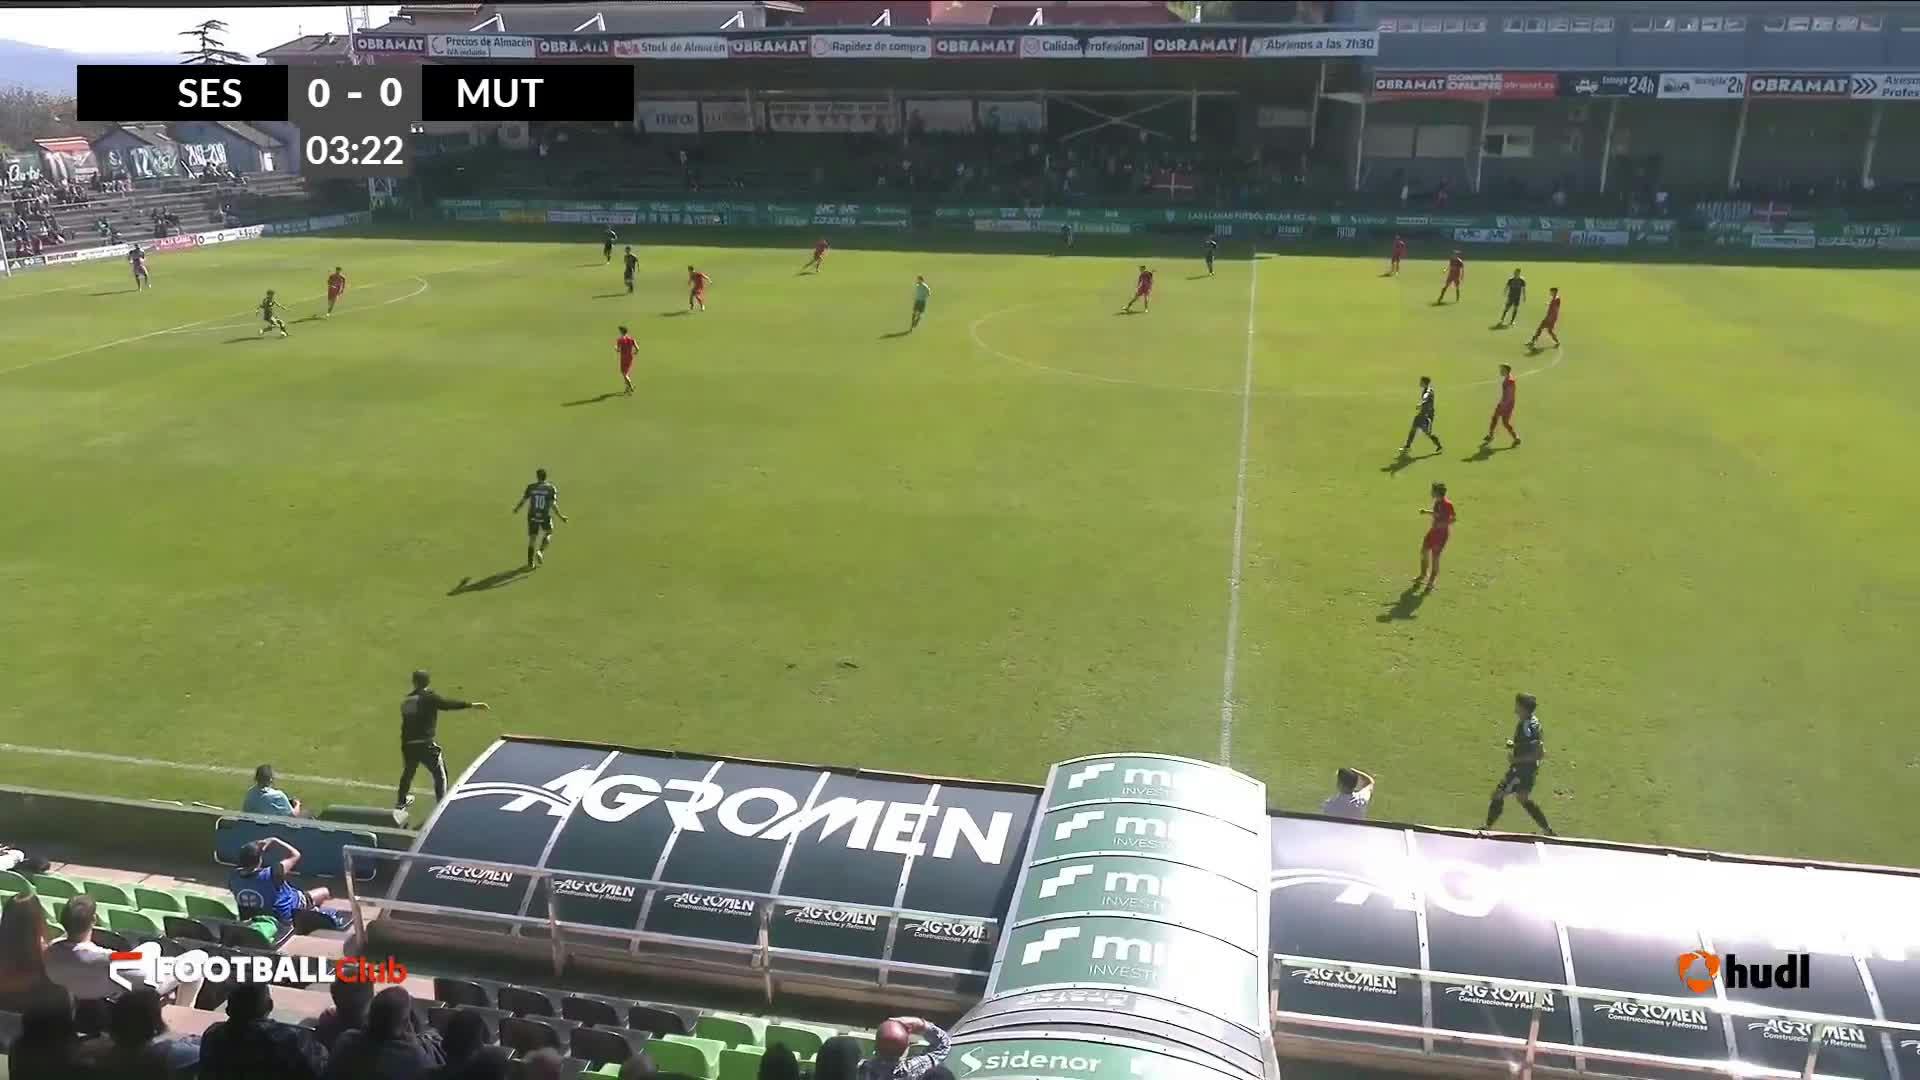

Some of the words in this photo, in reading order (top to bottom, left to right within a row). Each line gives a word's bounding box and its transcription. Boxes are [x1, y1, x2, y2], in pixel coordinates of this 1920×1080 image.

[357, 38, 424, 52] OBRAMAT
[734, 39, 807, 53] OBRAMAT
[936, 38, 1016, 53] OBRAMAT
[1153, 38, 1237, 52] OBRAMAT
[1325, 39, 1343, 49] las
[1345, 38, 1375, 49] 7h30
[1376, 79, 1445, 91] OBRAMAT
[1628, 76, 1655, 94] 24h
[1727, 76, 1743, 94] 2h
[1751, 77, 1849, 93] OBRAMAT
[500, 765, 1014, 865] AGROMEN
[439, 864, 513, 883] AGROMEN
[560, 879, 635, 898] AGROMEN
[676, 892, 754, 912] AGROMEN
[797, 906, 878, 926] AGROMEN
[1303, 978, 1357, 991] Construcciones
[1363, 984, 1397, 995] Reformas
[1305, 968, 1397, 989] AGROMEN
[1458, 996, 1513, 1008] Construcciones
[1608, 1001, 1706, 1024] AGROMEN
[1607, 1013, 1665, 1026] Construcciones
[1672, 1020, 1708, 1031] Reformas
[1830, 1037, 1867, 1049] Reformas
[985, 1050, 1101, 1073] sidenor
